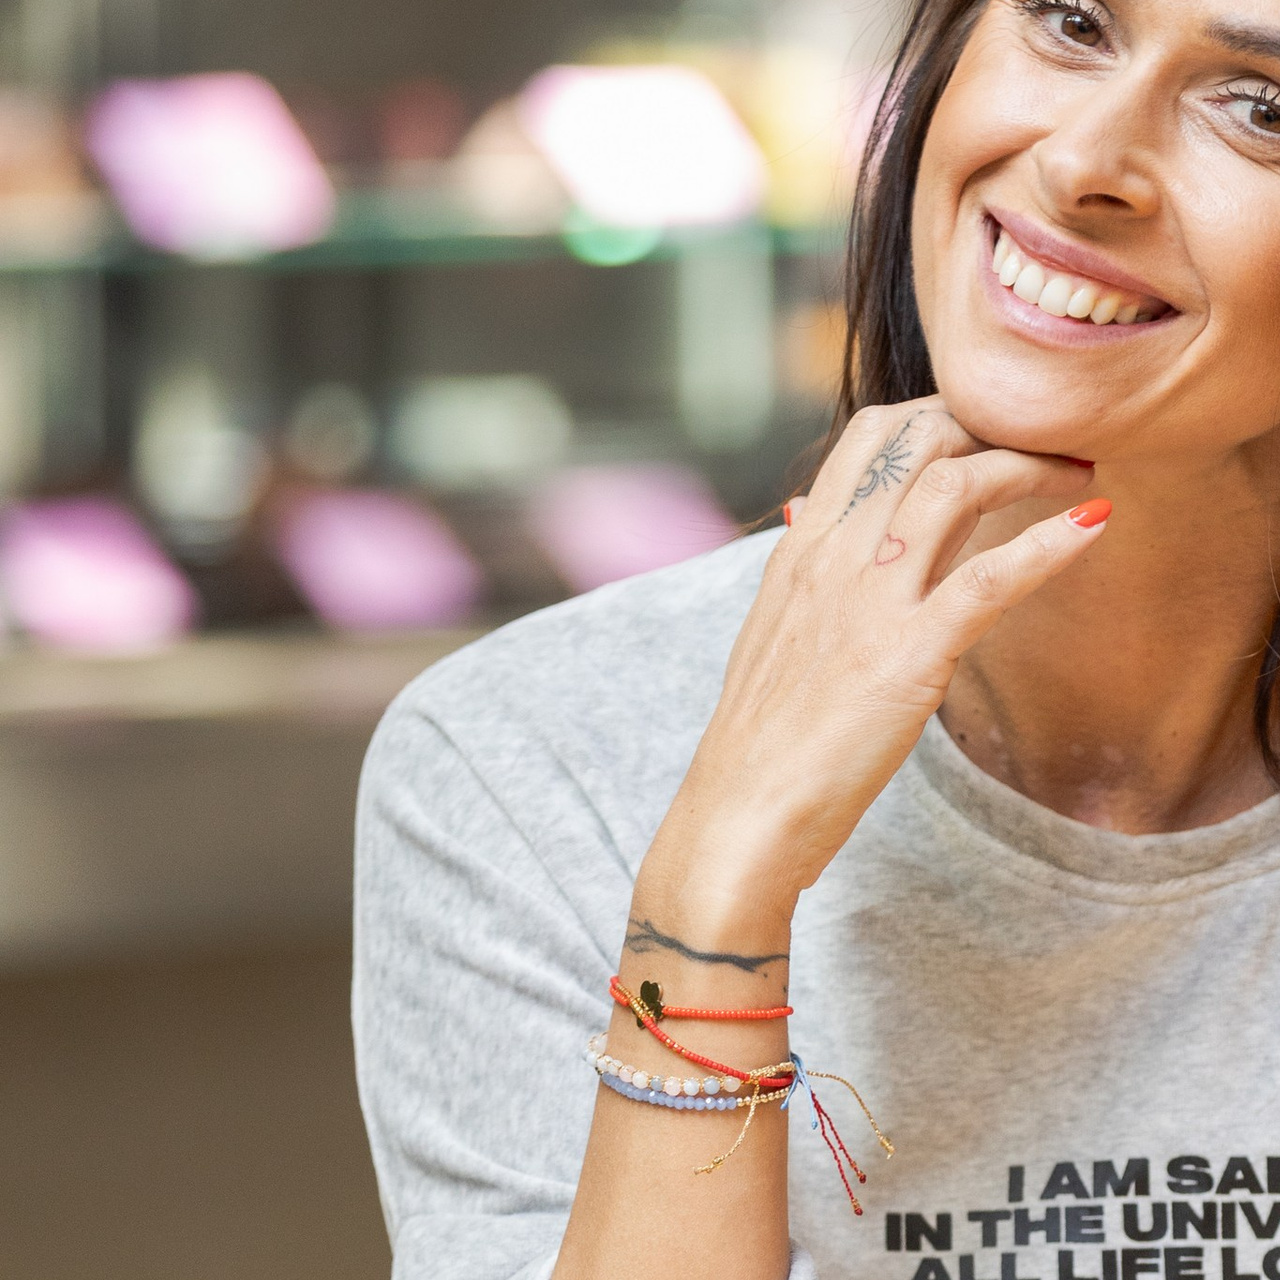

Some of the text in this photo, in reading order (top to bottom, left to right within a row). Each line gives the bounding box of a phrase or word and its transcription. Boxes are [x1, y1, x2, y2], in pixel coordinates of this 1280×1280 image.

[1007, 1165, 1025, 1203] I
[1039, 1157, 1150, 1201] AM
[884, 1212, 953, 1253] IN
[966, 1205, 1105, 1248] THE
